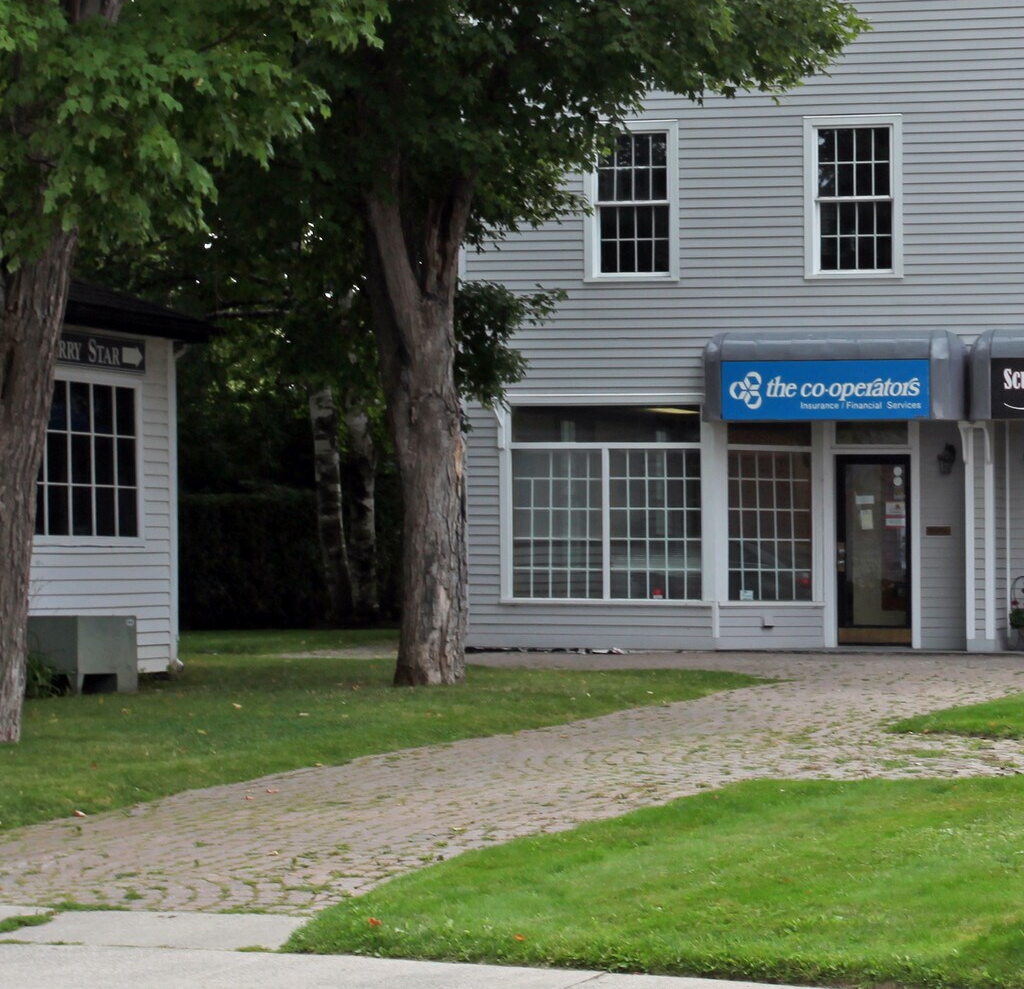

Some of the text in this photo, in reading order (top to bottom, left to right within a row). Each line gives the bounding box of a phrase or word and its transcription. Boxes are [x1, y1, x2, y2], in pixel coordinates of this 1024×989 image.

[88, 338, 121, 366] STAR
[766, 375, 921, 402] the co-operators
[800, 401, 840, 410] Insurance
[846, 401, 882, 410] Financial
[887, 401, 922, 410] Services
